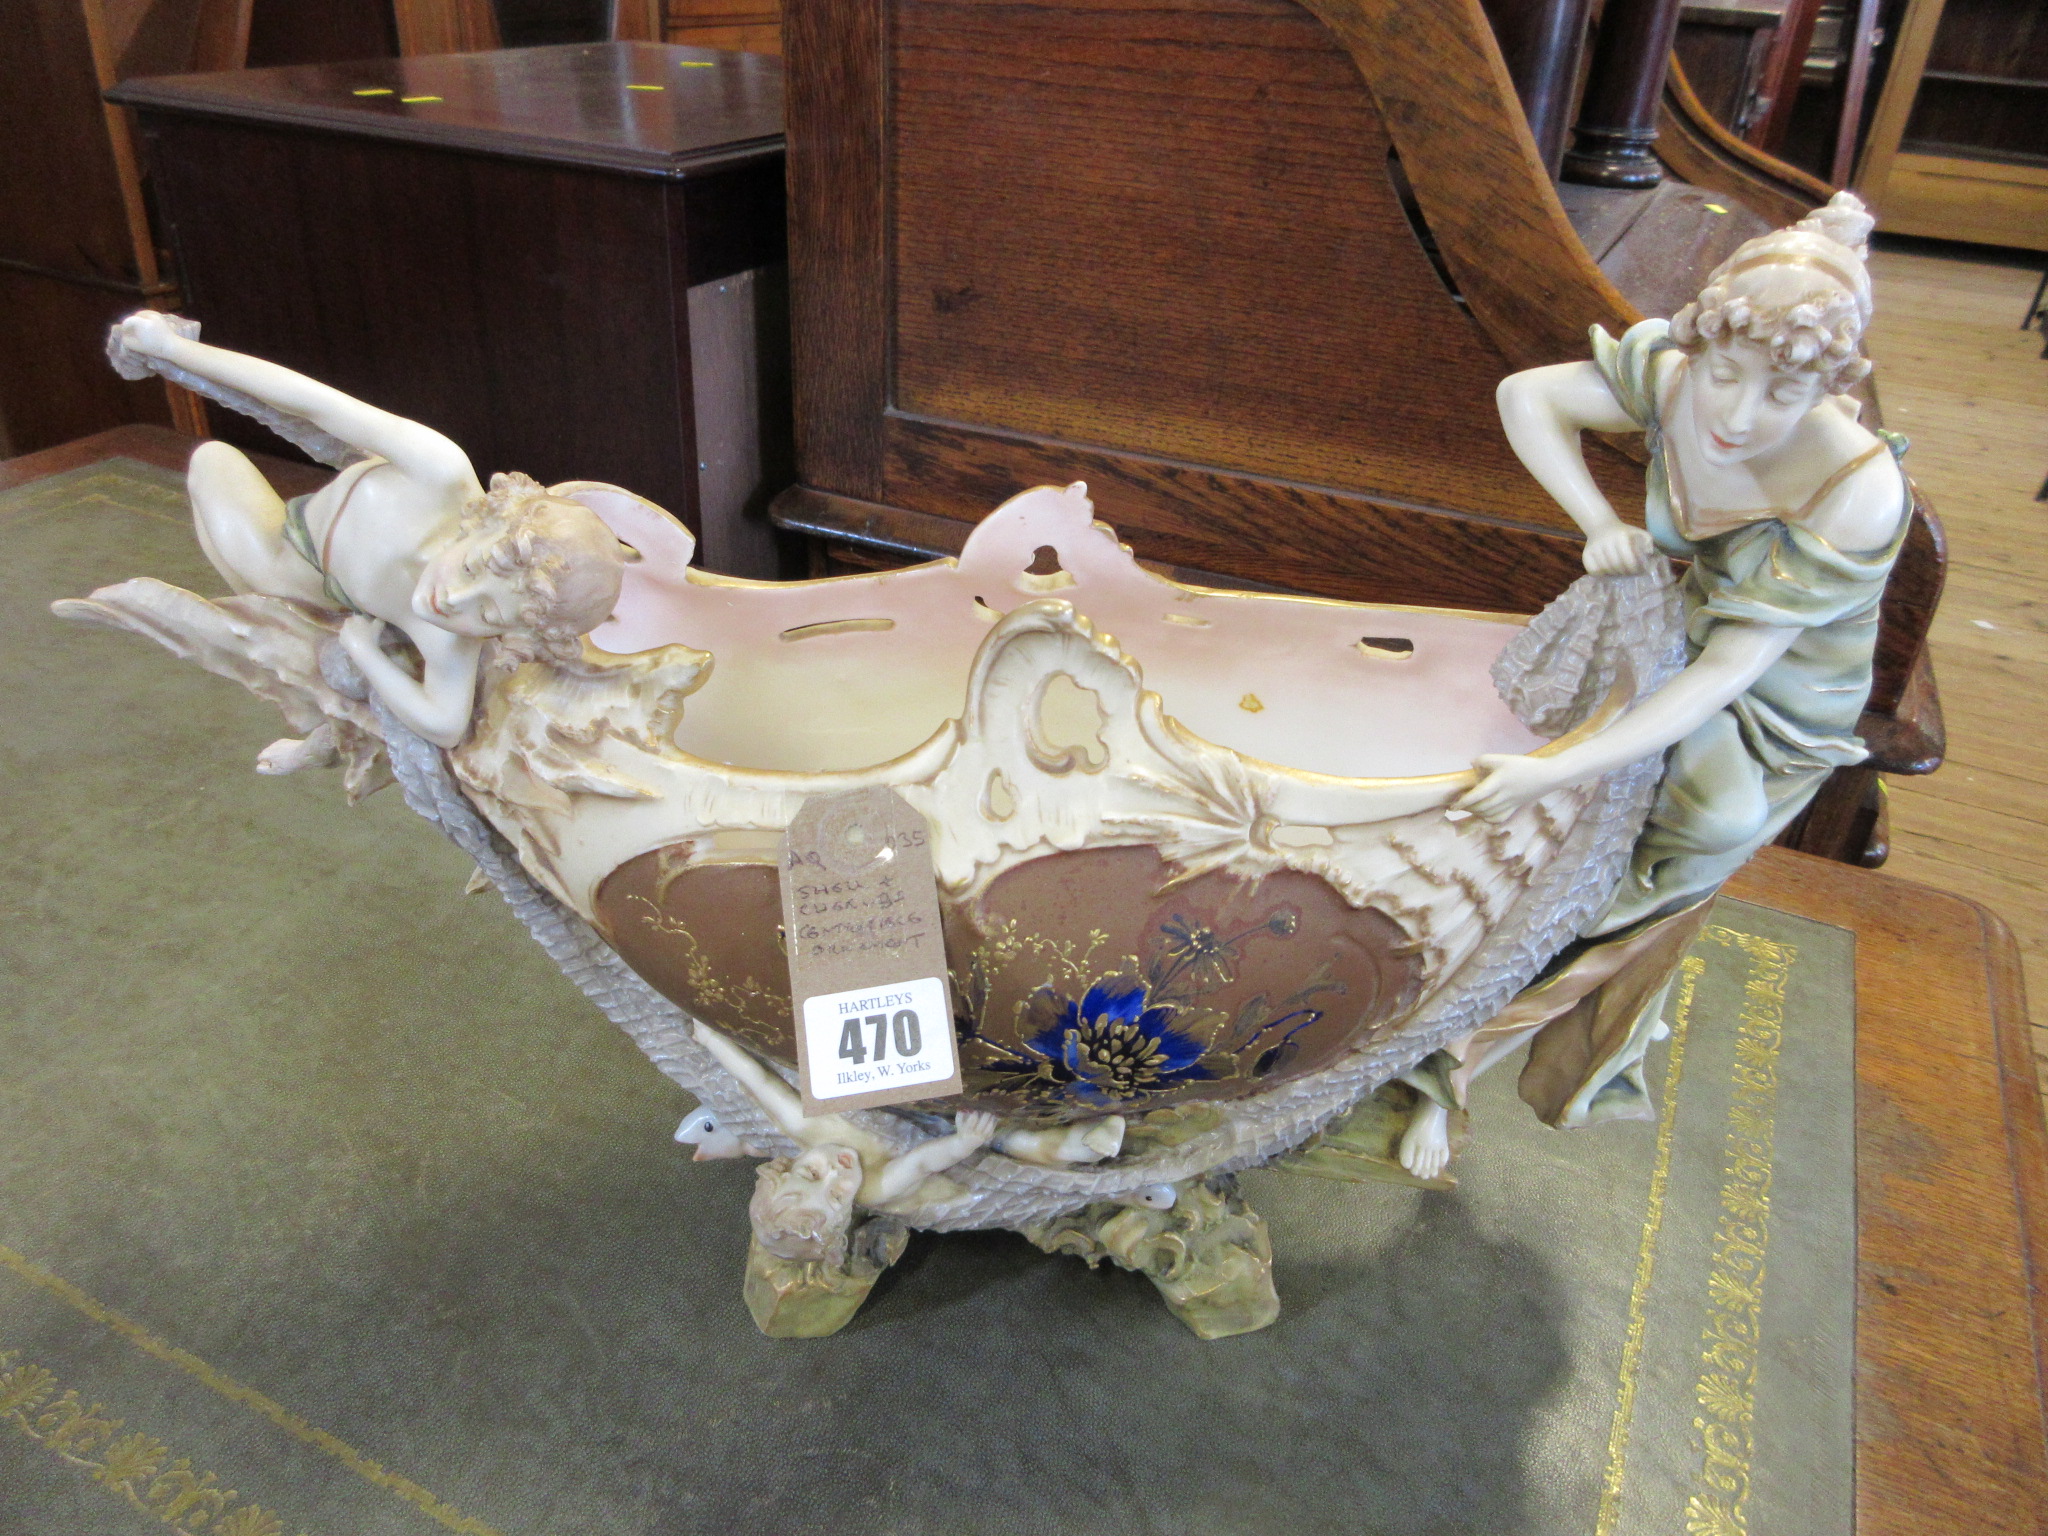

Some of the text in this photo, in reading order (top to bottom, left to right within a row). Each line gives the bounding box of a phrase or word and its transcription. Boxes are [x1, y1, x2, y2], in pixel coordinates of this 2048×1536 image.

[838, 992, 913, 1014] HARTLEYS
[838, 1009, 922, 1065] 470
[837, 1061, 931, 1084] Ilkley, W. Yorks
